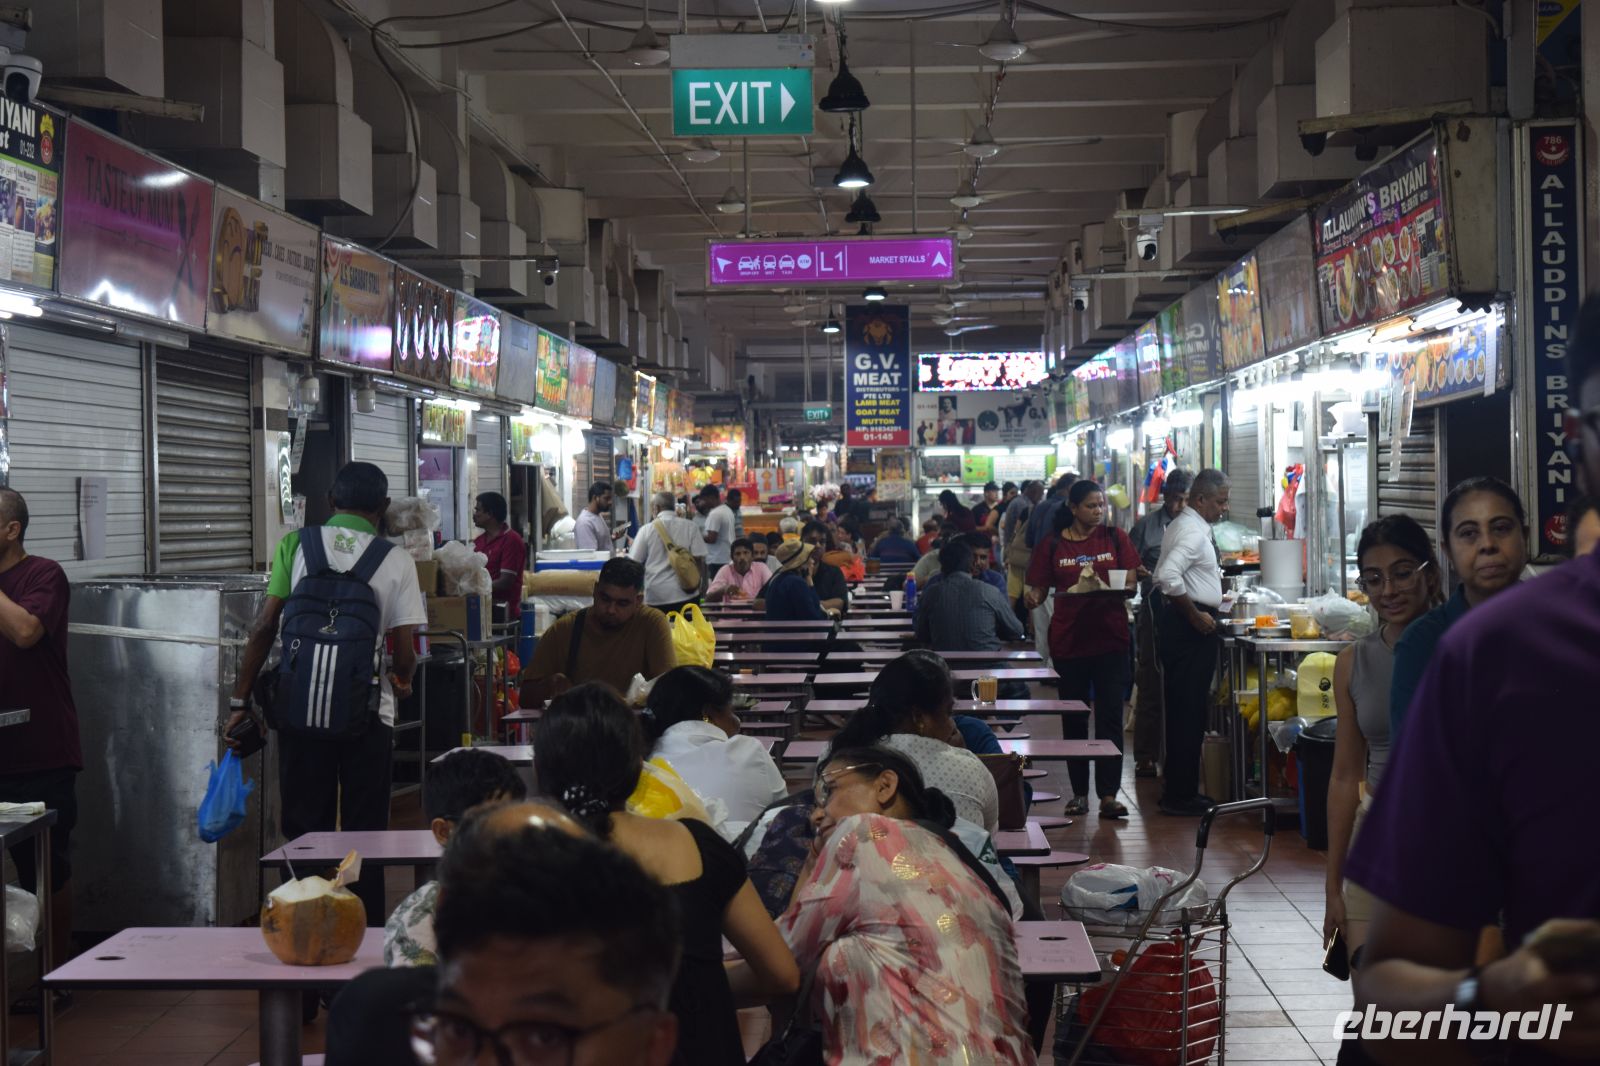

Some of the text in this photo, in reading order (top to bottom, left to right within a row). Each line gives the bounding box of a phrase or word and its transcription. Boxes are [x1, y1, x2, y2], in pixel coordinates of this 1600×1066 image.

[689, 81, 772, 125] EXIT
[1543, 136, 1562, 144] 786
[86, 155, 128, 213] TASTE
[1379, 161, 1428, 209] BRIYANI
[820, 251, 843, 272] L1
[869, 254, 926, 264] MARKET STALLS
[1539, 174, 1569, 359] ALLAUDDINS
[855, 353, 900, 370] G.V.
[853, 373, 902, 386] MEAT
[807, 410, 824, 419] EXIT
[863, 433, 894, 441] 01-145
[1546, 375, 1571, 503] BRIYANI
